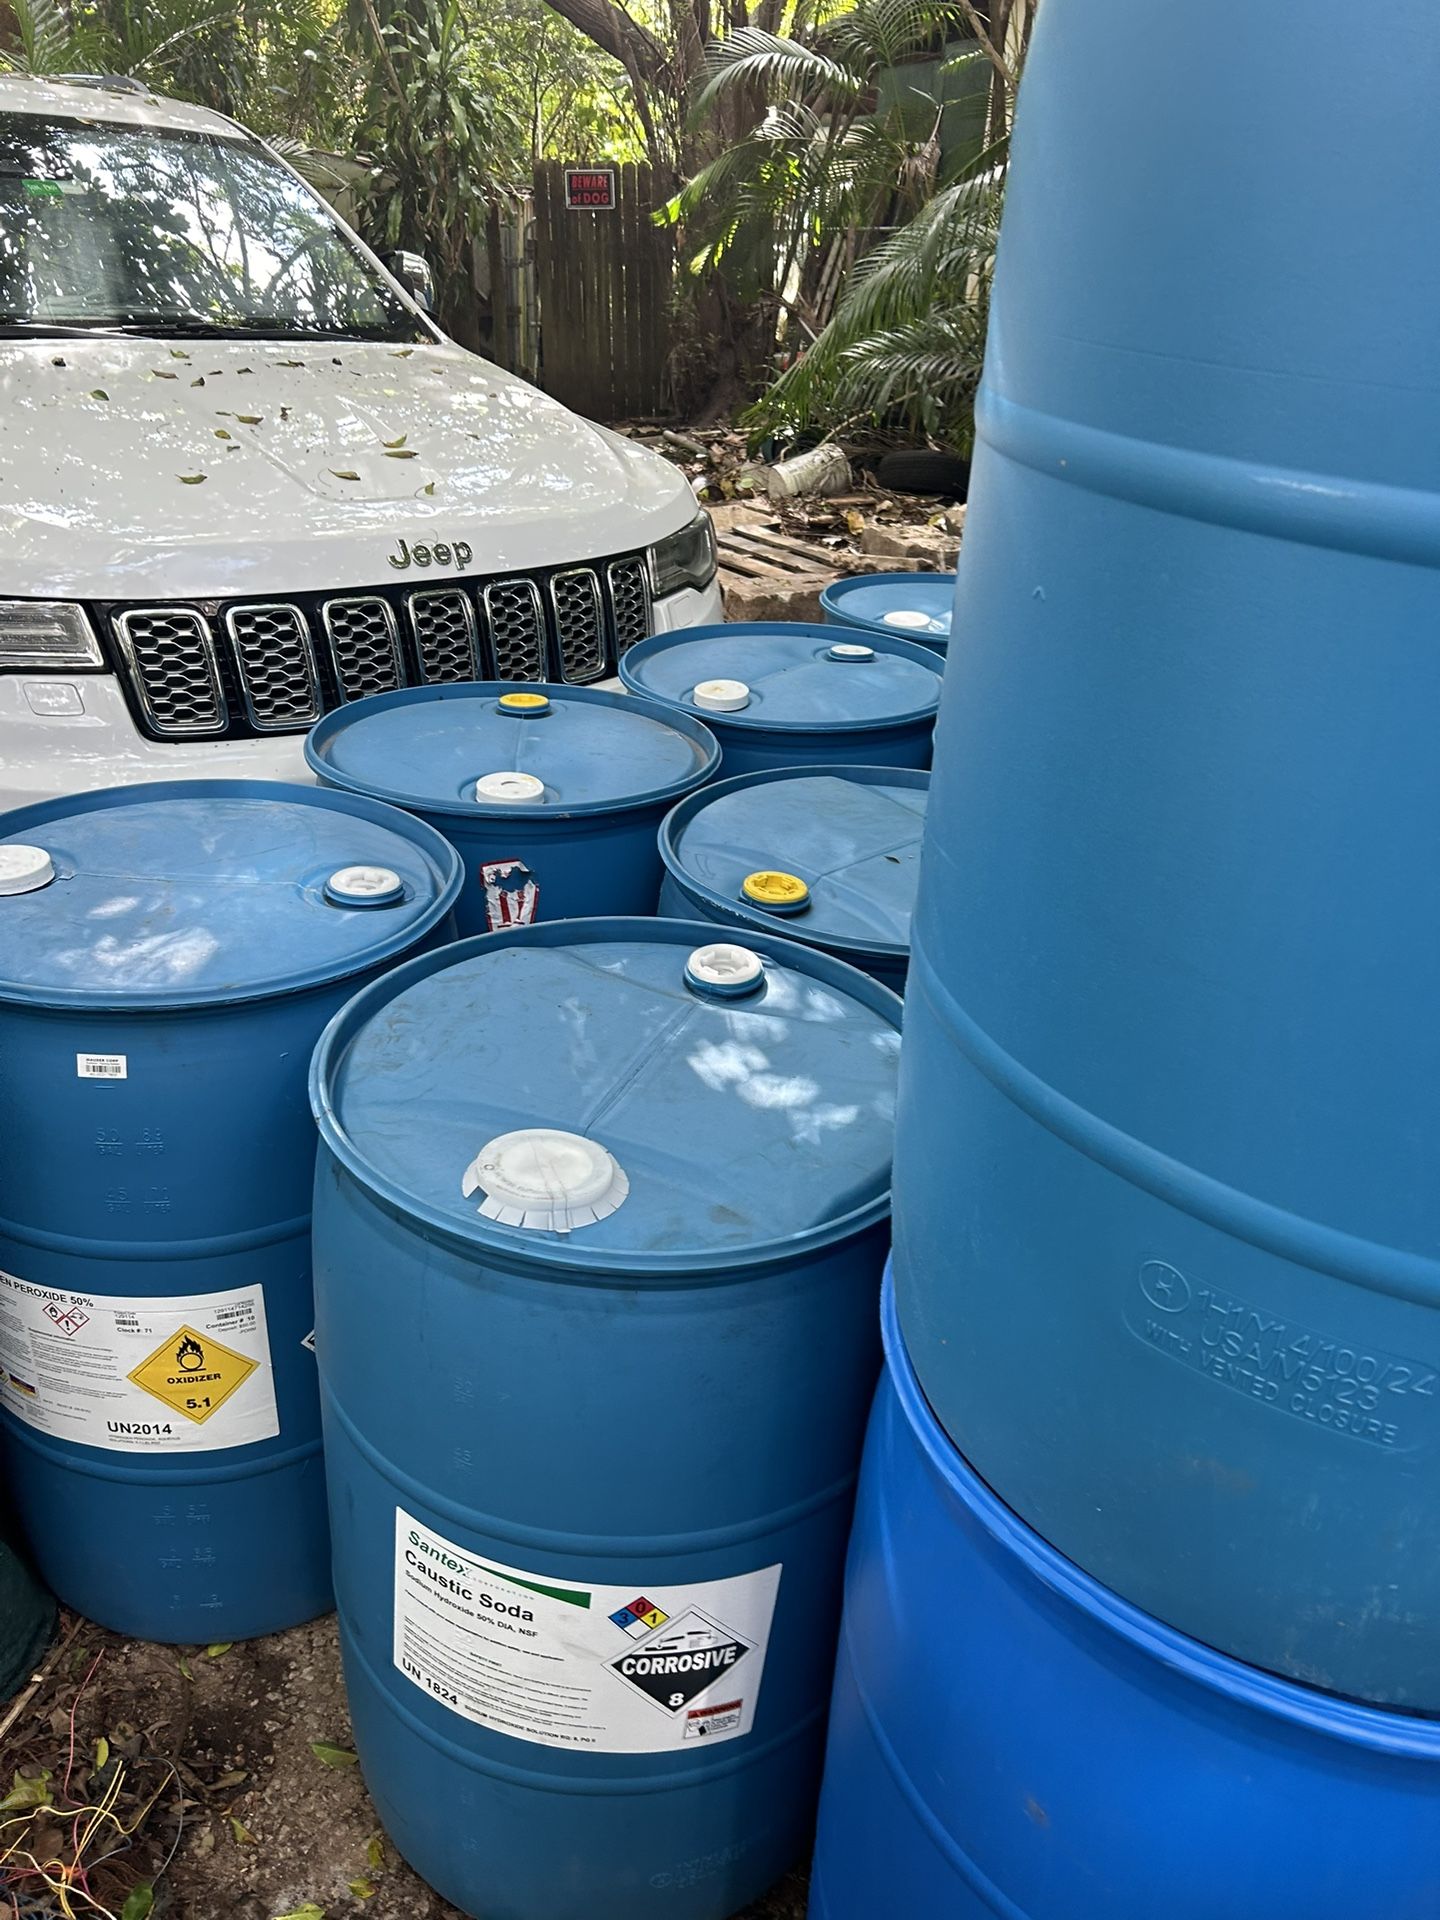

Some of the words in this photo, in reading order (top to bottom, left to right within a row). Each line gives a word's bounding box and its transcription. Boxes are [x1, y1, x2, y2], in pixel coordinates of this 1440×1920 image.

[571, 175, 608, 188] BEWARE
[572, 194, 581, 204] of
[583, 193, 609, 204] DOG
[386, 539, 473, 571] Jeep
[13, 1281, 68, 1303] PEROXIDE
[70, 1296, 94, 1308] 50%
[166, 1373, 222, 1385] OXIDIZER
[186, 1397, 211, 1409] 5.1
[1200, 1348, 1280, 1402] VENTED
[1290, 1392, 1400, 1444] CLOSURE
[107, 1421, 173, 1435] UN2014
[408, 1530, 472, 1579] Santex
[405, 1550, 473, 1601] Caustic
[479, 1593, 534, 1622] Soda
[405, 1569, 433, 1594] Sodium
[433, 1590, 475, 1617] Hydroxide
[476, 1613, 495, 1626] 50%
[518, 1627, 538, 1639] NSF
[635, 1601, 646, 1614] 0
[619, 1612, 630, 1624] 3
[648, 1613, 658, 1624] 1
[621, 1645, 737, 1676] CORROSIVE
[402, 1657, 421, 1680] UN
[426, 1678, 459, 1706] 1824
[668, 1693, 685, 1707] 8
